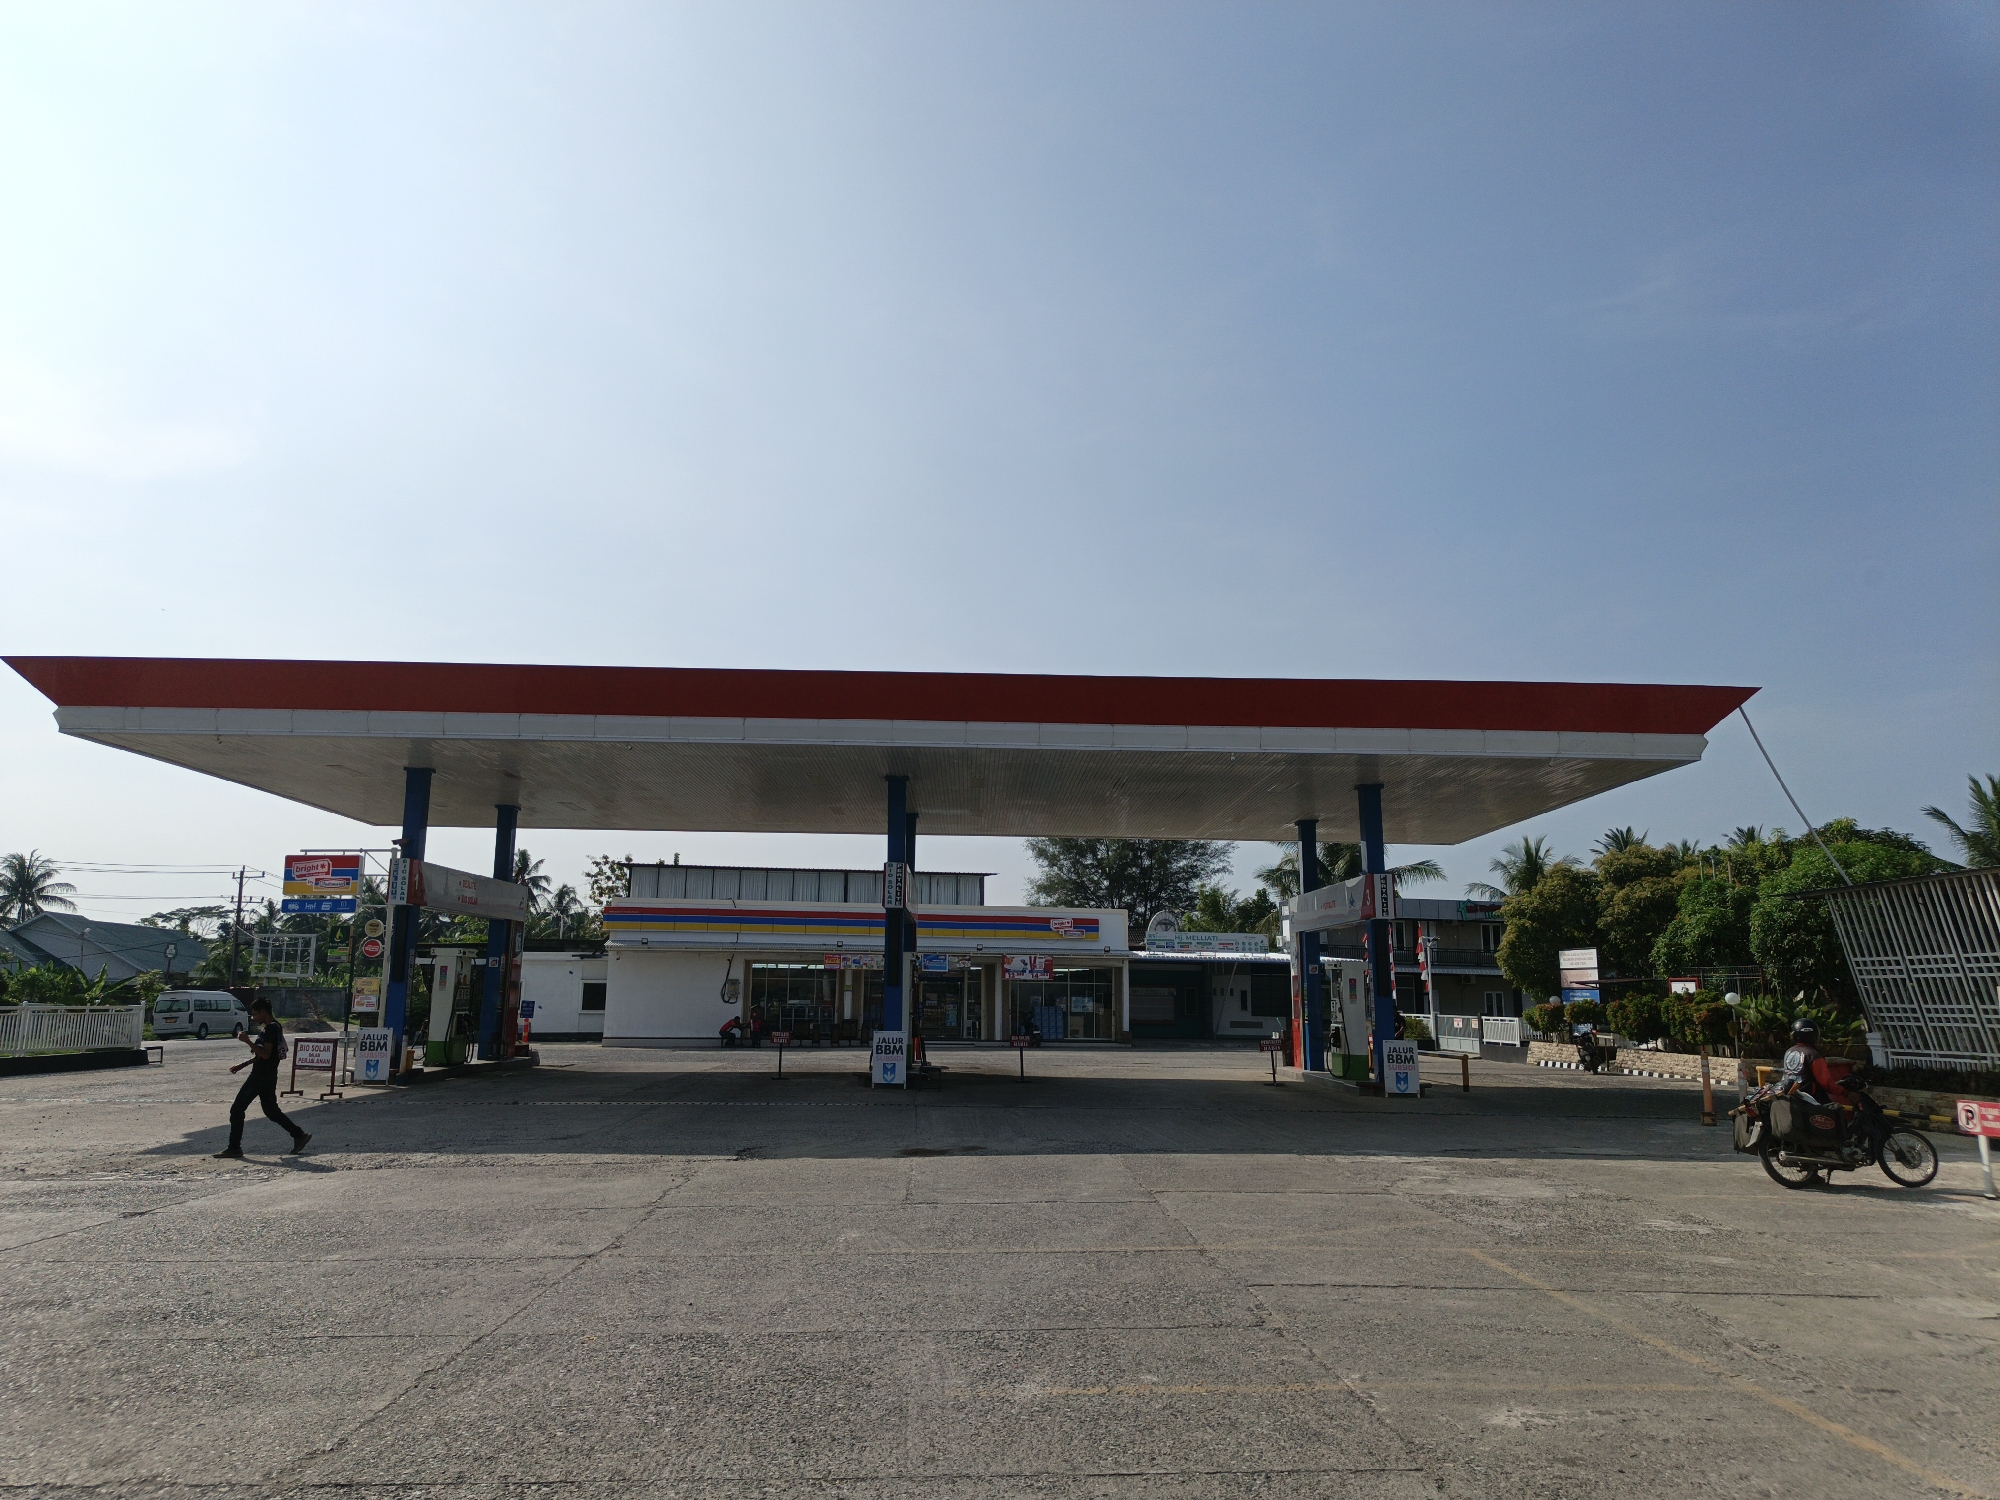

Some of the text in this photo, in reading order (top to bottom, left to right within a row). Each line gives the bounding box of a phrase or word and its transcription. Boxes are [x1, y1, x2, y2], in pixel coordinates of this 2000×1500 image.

[295, 863, 319, 873] bright
[399, 875, 407, 901] SOLAR
[1380, 874, 1389, 917] PERTALITE
[361, 1033, 389, 1041] JALUR
[876, 1036, 904, 1045] JALUR
[299, 1044, 331, 1053] BIO SOLAR
[359, 1040, 388, 1052] BBM
[875, 1044, 904, 1056] BBM
[1387, 1046, 1415, 1055] JALUR
[359, 1051, 388, 1059] SUBSIDI
[875, 1054, 904, 1062] SUBSIDI
[1386, 1053, 1416, 1065] BBM
[297, 1057, 331, 1065] PERJALANAN
[1387, 1063, 1416, 1071] SUBSIDI
